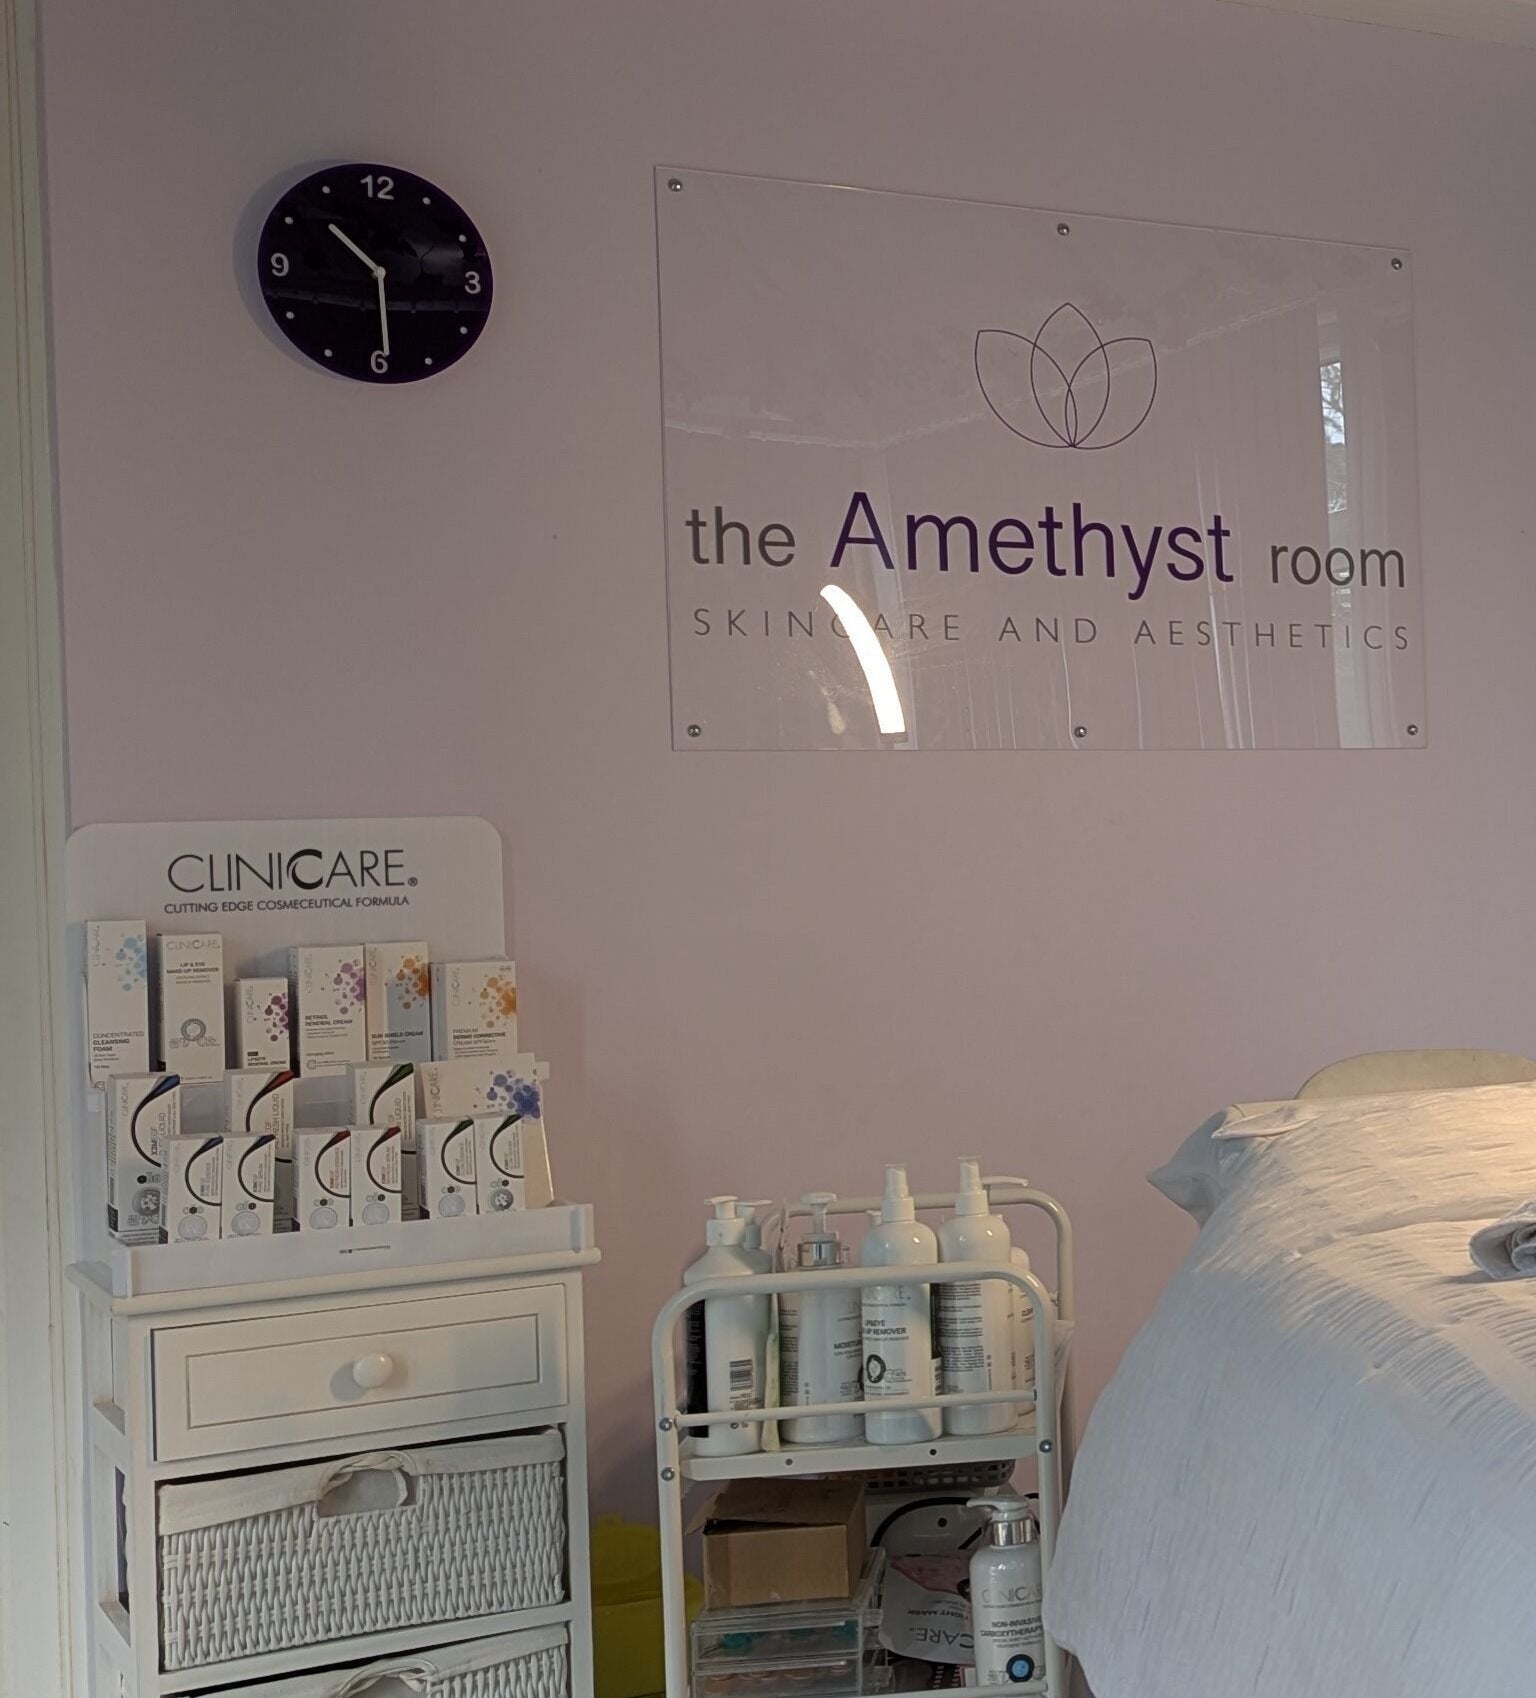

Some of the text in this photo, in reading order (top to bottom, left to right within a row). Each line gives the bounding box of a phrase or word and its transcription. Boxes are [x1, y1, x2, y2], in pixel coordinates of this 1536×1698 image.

[360, 174, 395, 200] 12
[270, 252, 290, 278] 9
[464, 270, 482, 295] 3
[369, 350, 389, 374] 6
[685, 490, 1406, 601] the Amethyst room
[693, 607, 1409, 651] SKINCARE AND AESTHETICS
[164, 895, 410, 915] CUTTING EDGE COSMECEUTICAL FORMULA
